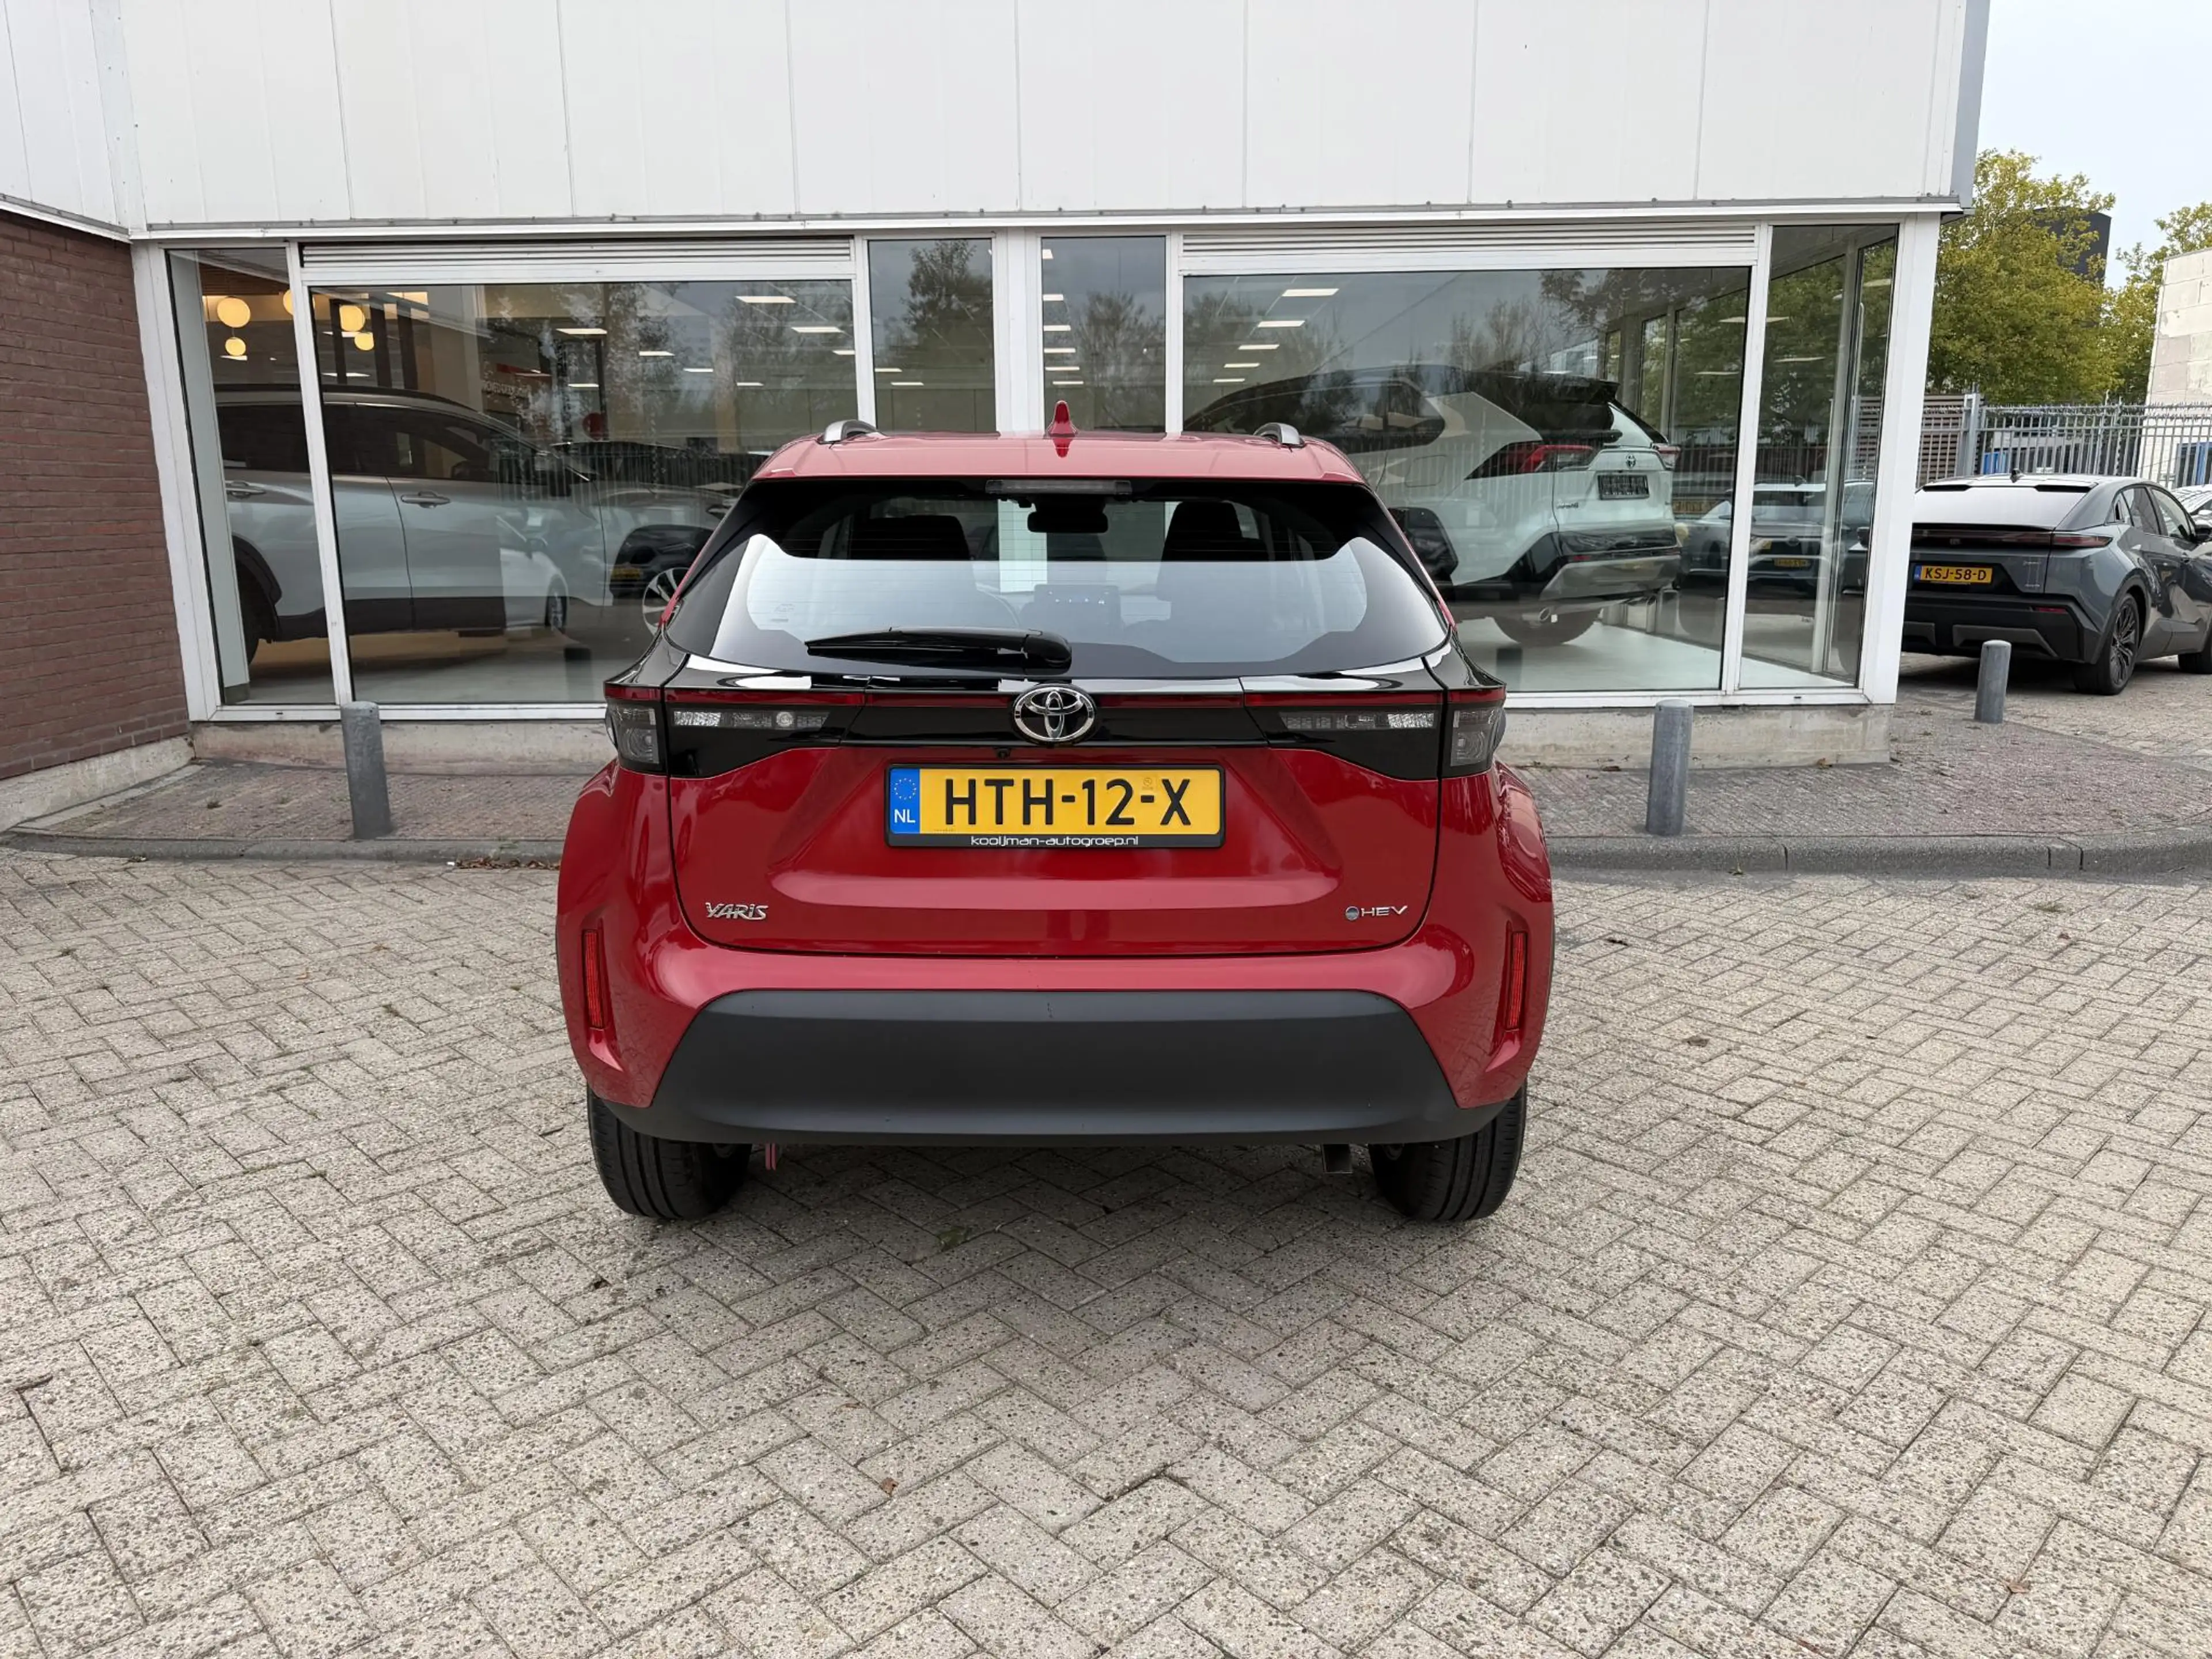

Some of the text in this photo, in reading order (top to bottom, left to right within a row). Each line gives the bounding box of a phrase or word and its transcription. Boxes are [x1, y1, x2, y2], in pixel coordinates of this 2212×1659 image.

[1925, 568, 1986, 580] KSJ-58-D
[945, 778, 1191, 825] HTH-12-X
[894, 809, 916, 823] NL
[971, 836, 1138, 847] kooijman-autogroep.nl
[1361, 905, 1408, 916] HEV
